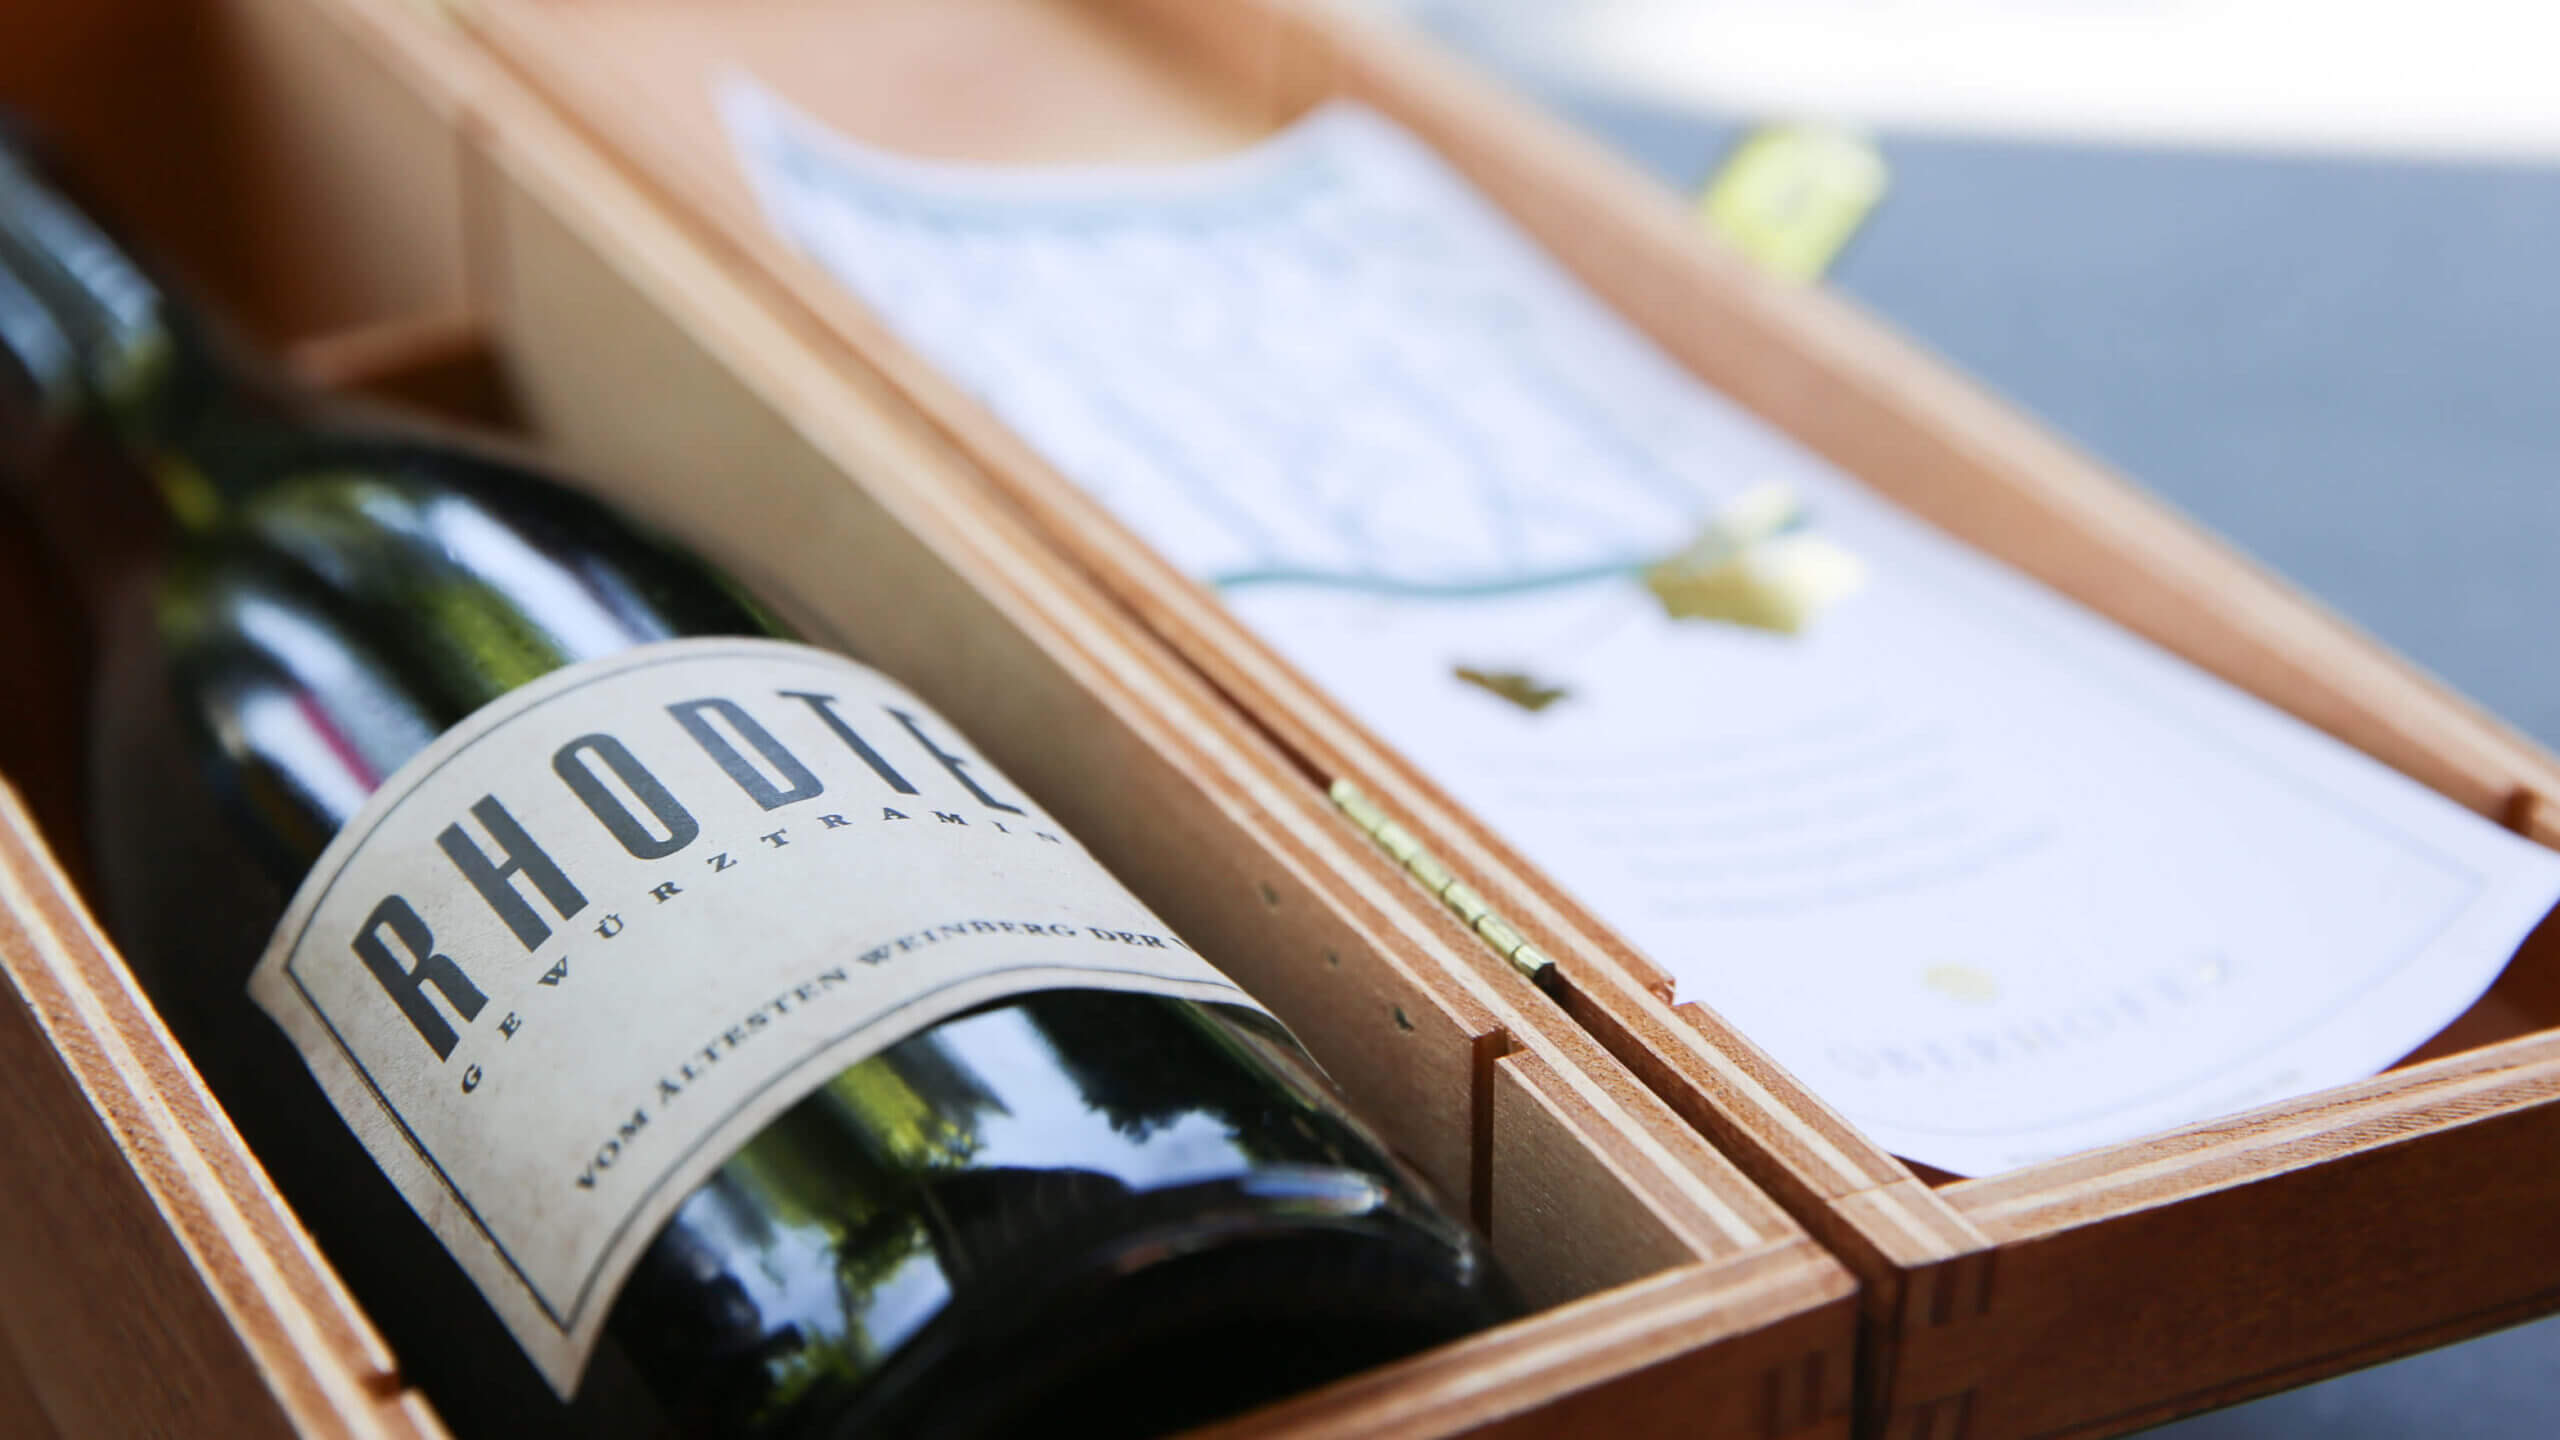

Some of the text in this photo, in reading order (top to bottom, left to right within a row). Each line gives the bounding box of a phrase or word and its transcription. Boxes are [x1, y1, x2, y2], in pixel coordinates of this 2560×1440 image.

[576, 919, 1169, 1190] VOM ÄLTESTEN WEINBERG DER
